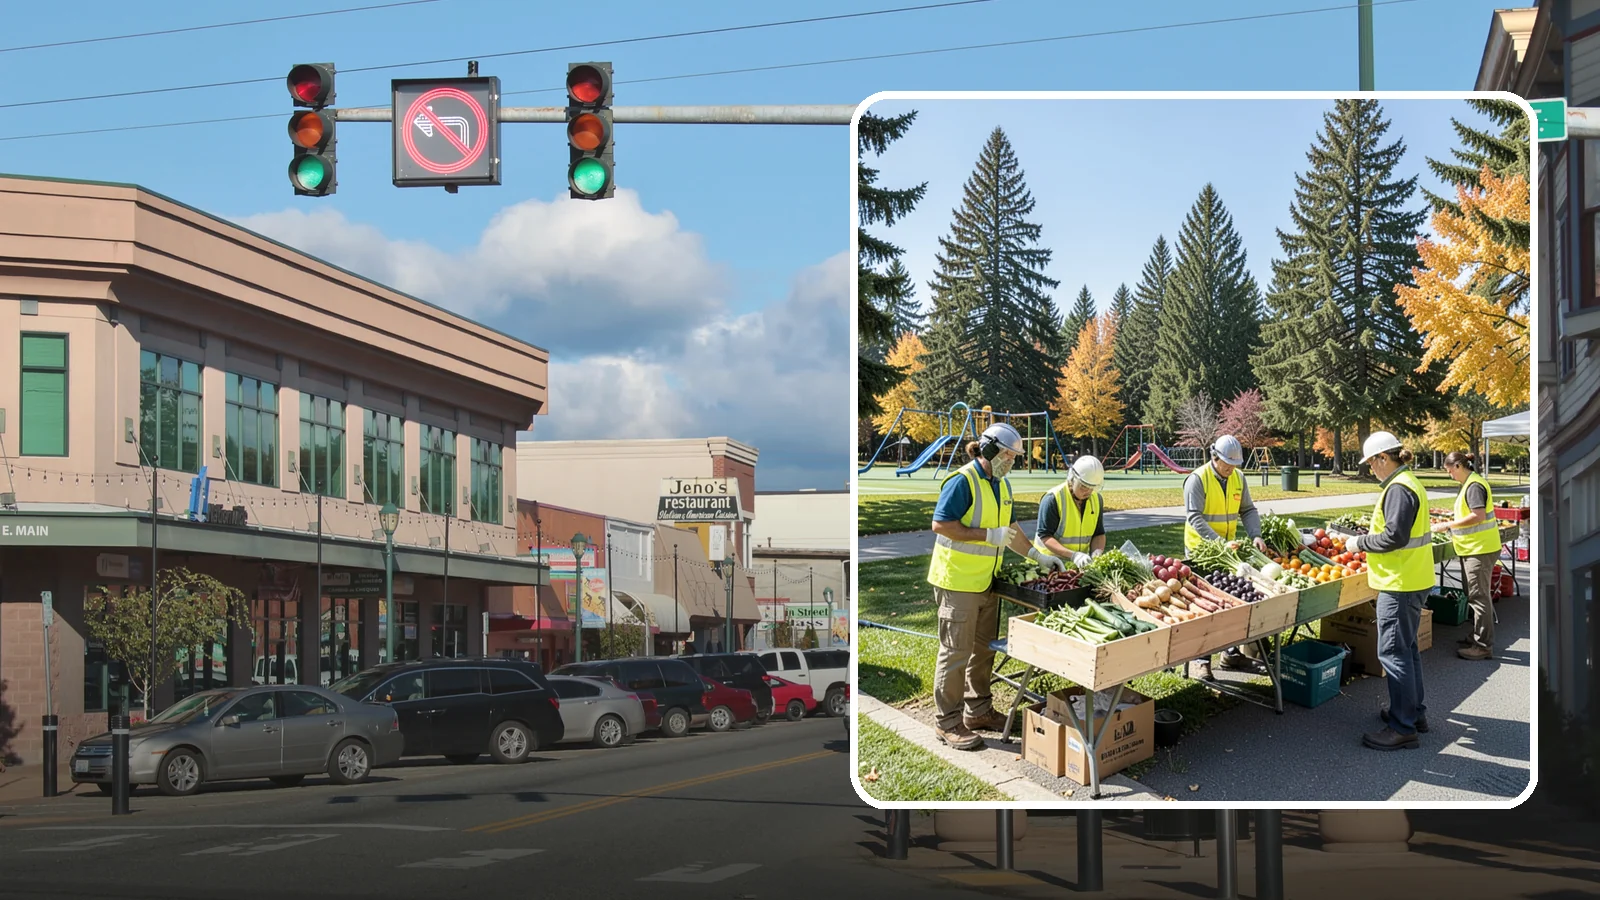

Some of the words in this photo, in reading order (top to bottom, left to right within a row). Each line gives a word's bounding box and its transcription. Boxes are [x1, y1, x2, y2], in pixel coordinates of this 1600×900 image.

[669, 480, 728, 495] Jeno's
[665, 496, 731, 509] restaurant
[658, 510, 682, 520] Italian
[686, 510, 715, 520] American
[715, 509, 738, 519] Cuisine
[2, 525, 13, 536] E.
[15, 525, 49, 536] MAIN
[785, 607, 795, 617] in
[797, 607, 829, 617] Street
[791, 619, 824, 627] lass
